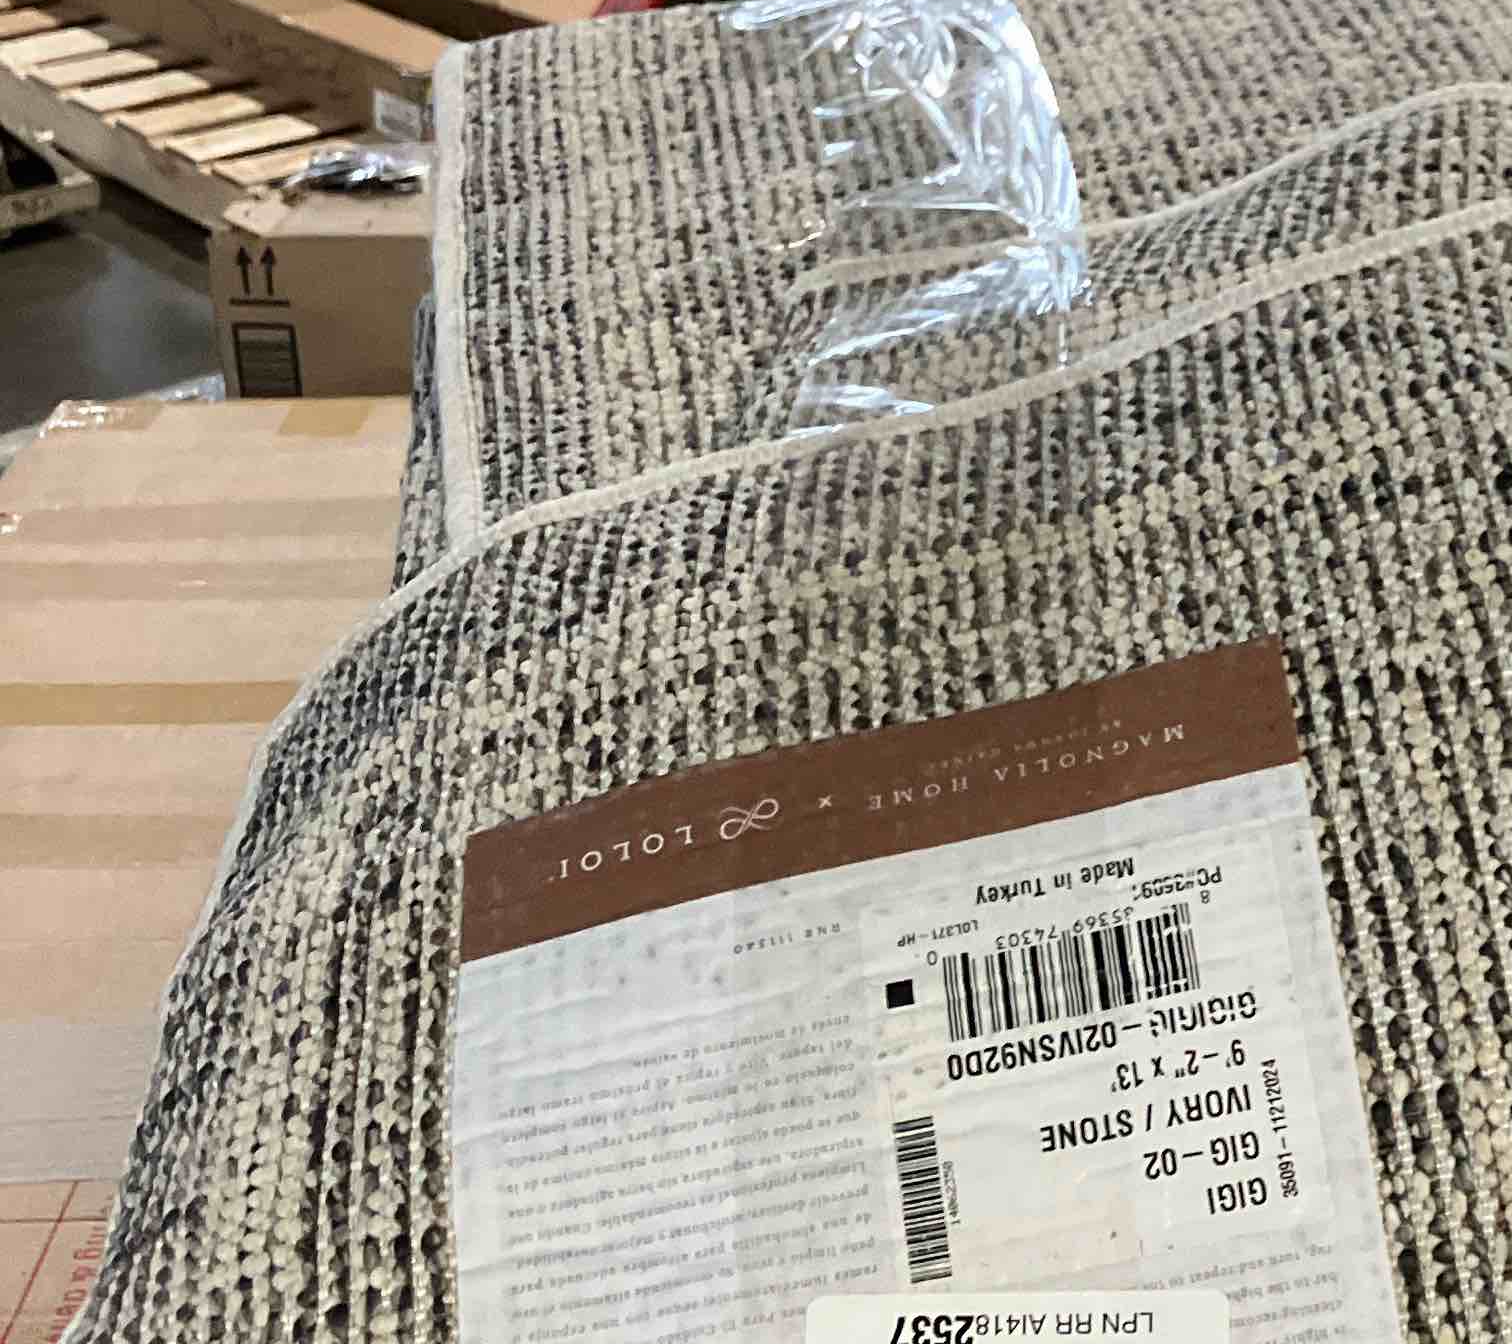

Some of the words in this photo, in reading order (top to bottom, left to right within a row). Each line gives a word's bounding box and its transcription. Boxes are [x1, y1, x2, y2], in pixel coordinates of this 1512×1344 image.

[990, 722, 1186, 783] MAGNOLIA
[866, 773, 970, 812] HOME
[555, 824, 694, 878] LOLOI
[1051, 872, 1072, 890] in
[1074, 856, 1135, 886] Made
[972, 873, 1045, 908] Turkey
[993, 924, 1059, 950] 74303
[1105, 1060, 1143, 1092] 13'
[1142, 1102, 1157, 1130] /
[1162, 1082, 1253, 1126] IVORY
[1037, 1107, 1134, 1153] STONE
[1140, 1128, 1261, 1180] GIG-02
[1203, 1176, 1269, 1215] GIGI
[1055, 1312, 1091, 1333] RR
[1102, 1311, 1153, 1333] LPN
